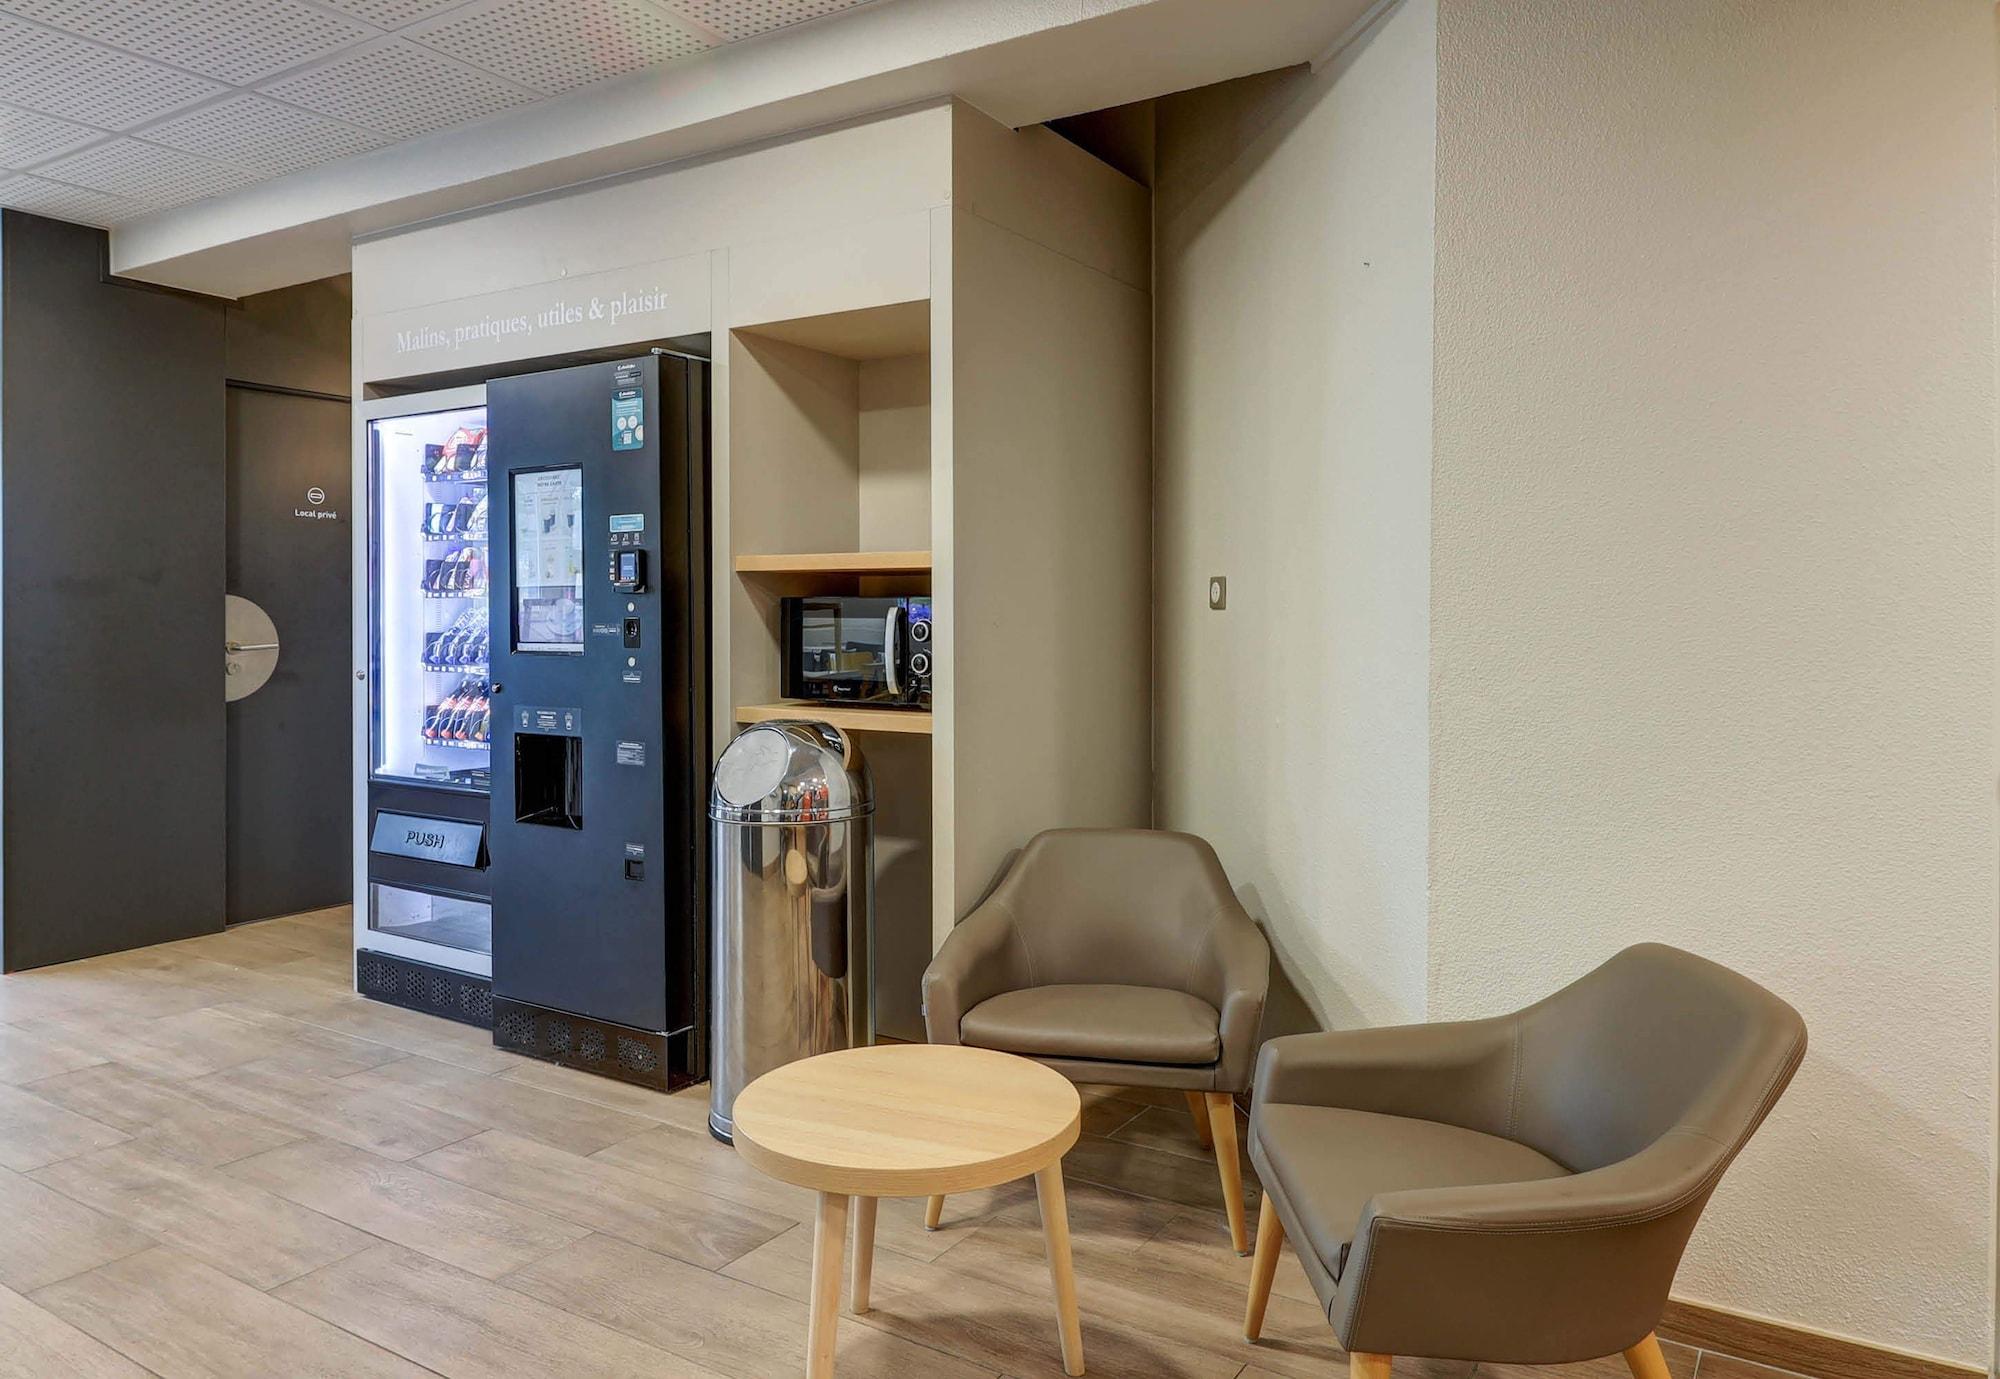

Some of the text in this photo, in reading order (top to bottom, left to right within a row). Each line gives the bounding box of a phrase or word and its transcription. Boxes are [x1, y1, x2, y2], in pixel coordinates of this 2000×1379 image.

[397, 286, 668, 352] Malins, pratiques, utiles & plaisir
[295, 509, 337, 520] Local privé
[405, 831, 445, 849] PUSH
